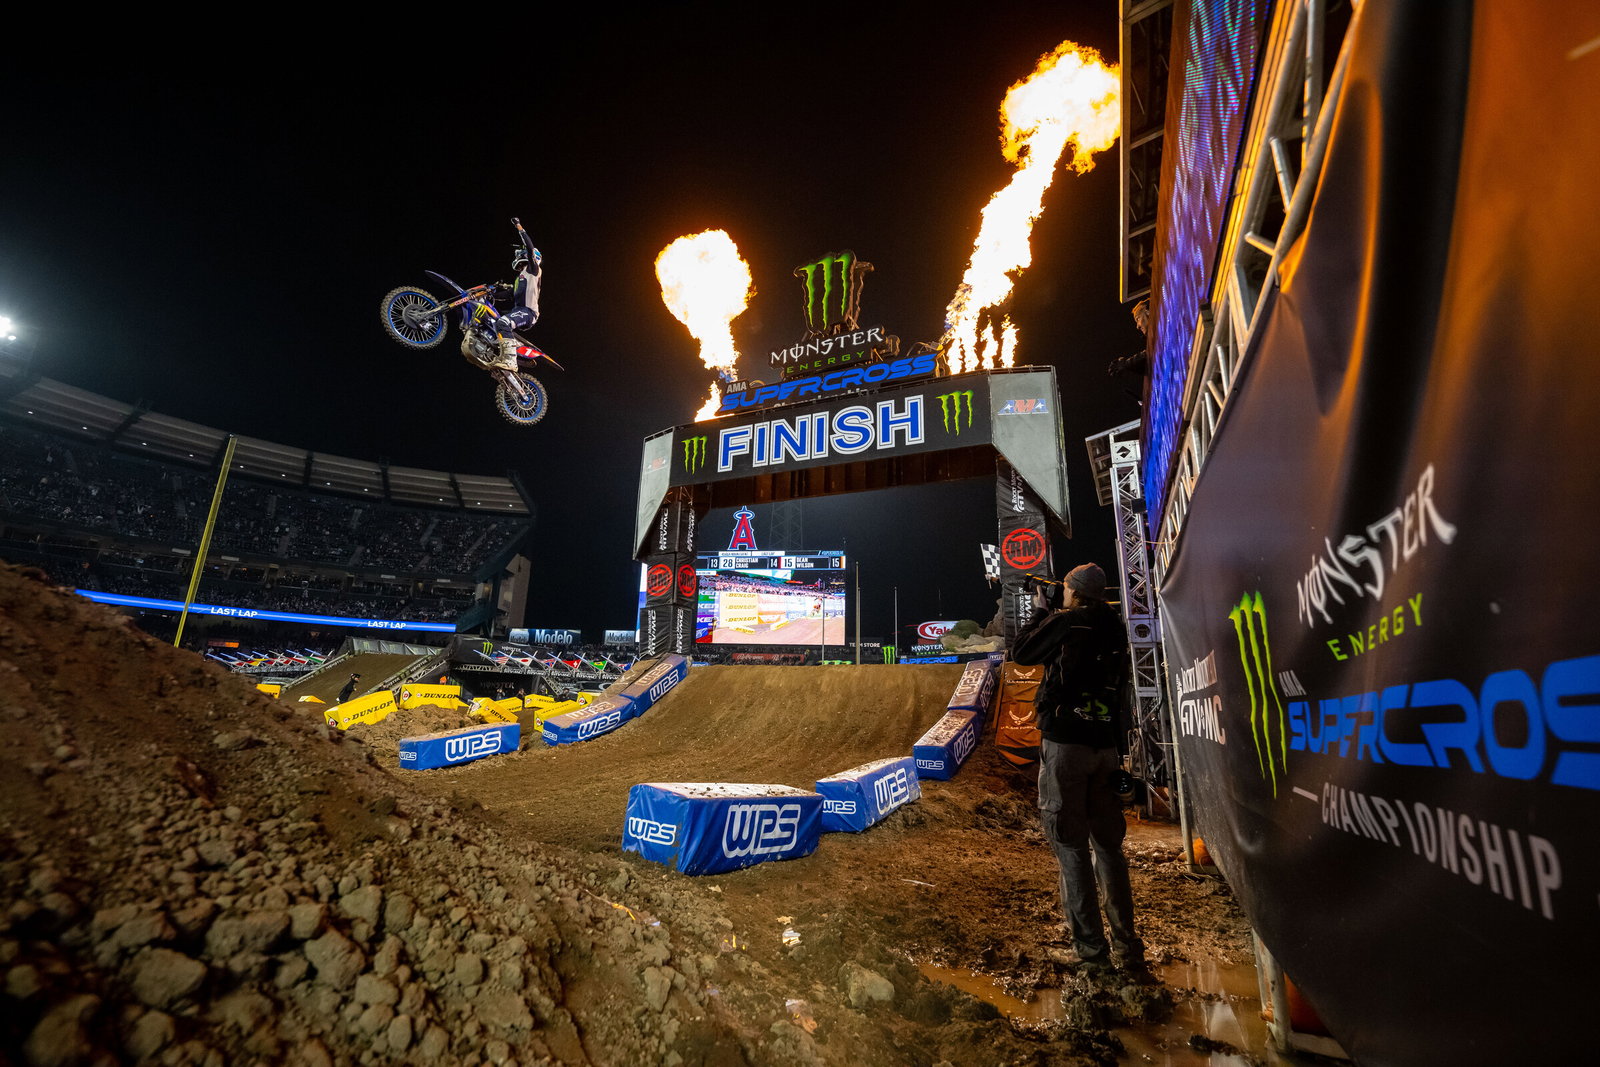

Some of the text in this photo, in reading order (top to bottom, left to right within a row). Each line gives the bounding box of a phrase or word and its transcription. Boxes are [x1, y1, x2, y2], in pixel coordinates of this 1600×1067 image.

[524, 348, 533, 357] 1
[770, 327, 883, 364] MONSTER
[786, 350, 865, 374] ENERGY
[720, 353, 938, 412] SUPERCROSS
[726, 382, 747, 394] AMA
[998, 398, 1049, 416] AMA
[717, 394, 925, 473] FINISH
[1297, 463, 1458, 628] MONSTER
[710, 558, 718, 568] 13
[723, 558, 733, 568] 28
[771, 558, 778, 568] 14
[784, 558, 793, 568] 15
[832, 558, 840, 568] 15
[210, 607, 258, 618] LAST LAP
[367, 620, 406, 629] LAST LAP
[1326, 592, 1424, 661] ENERGY
[535, 630, 573, 644] Modelo
[911, 644, 944, 652] MONSTER
[650, 669, 679, 702] WPS
[1278, 670, 1307, 697] AMA
[352, 700, 394, 720] DUNLOP
[490, 709, 512, 723] DUNLO
[578, 711, 621, 740] WPS
[1287, 654, 1600, 791] SUPERCROS
[445, 730, 502, 762] WPS
[917, 759, 945, 770] WPS
[874, 767, 910, 815] WPS
[821, 800, 857, 815] WPS
[629, 817, 677, 846] WPS
[722, 804, 801, 859] WPS
[1321, 782, 1562, 921] CHAMPIONSHIP
